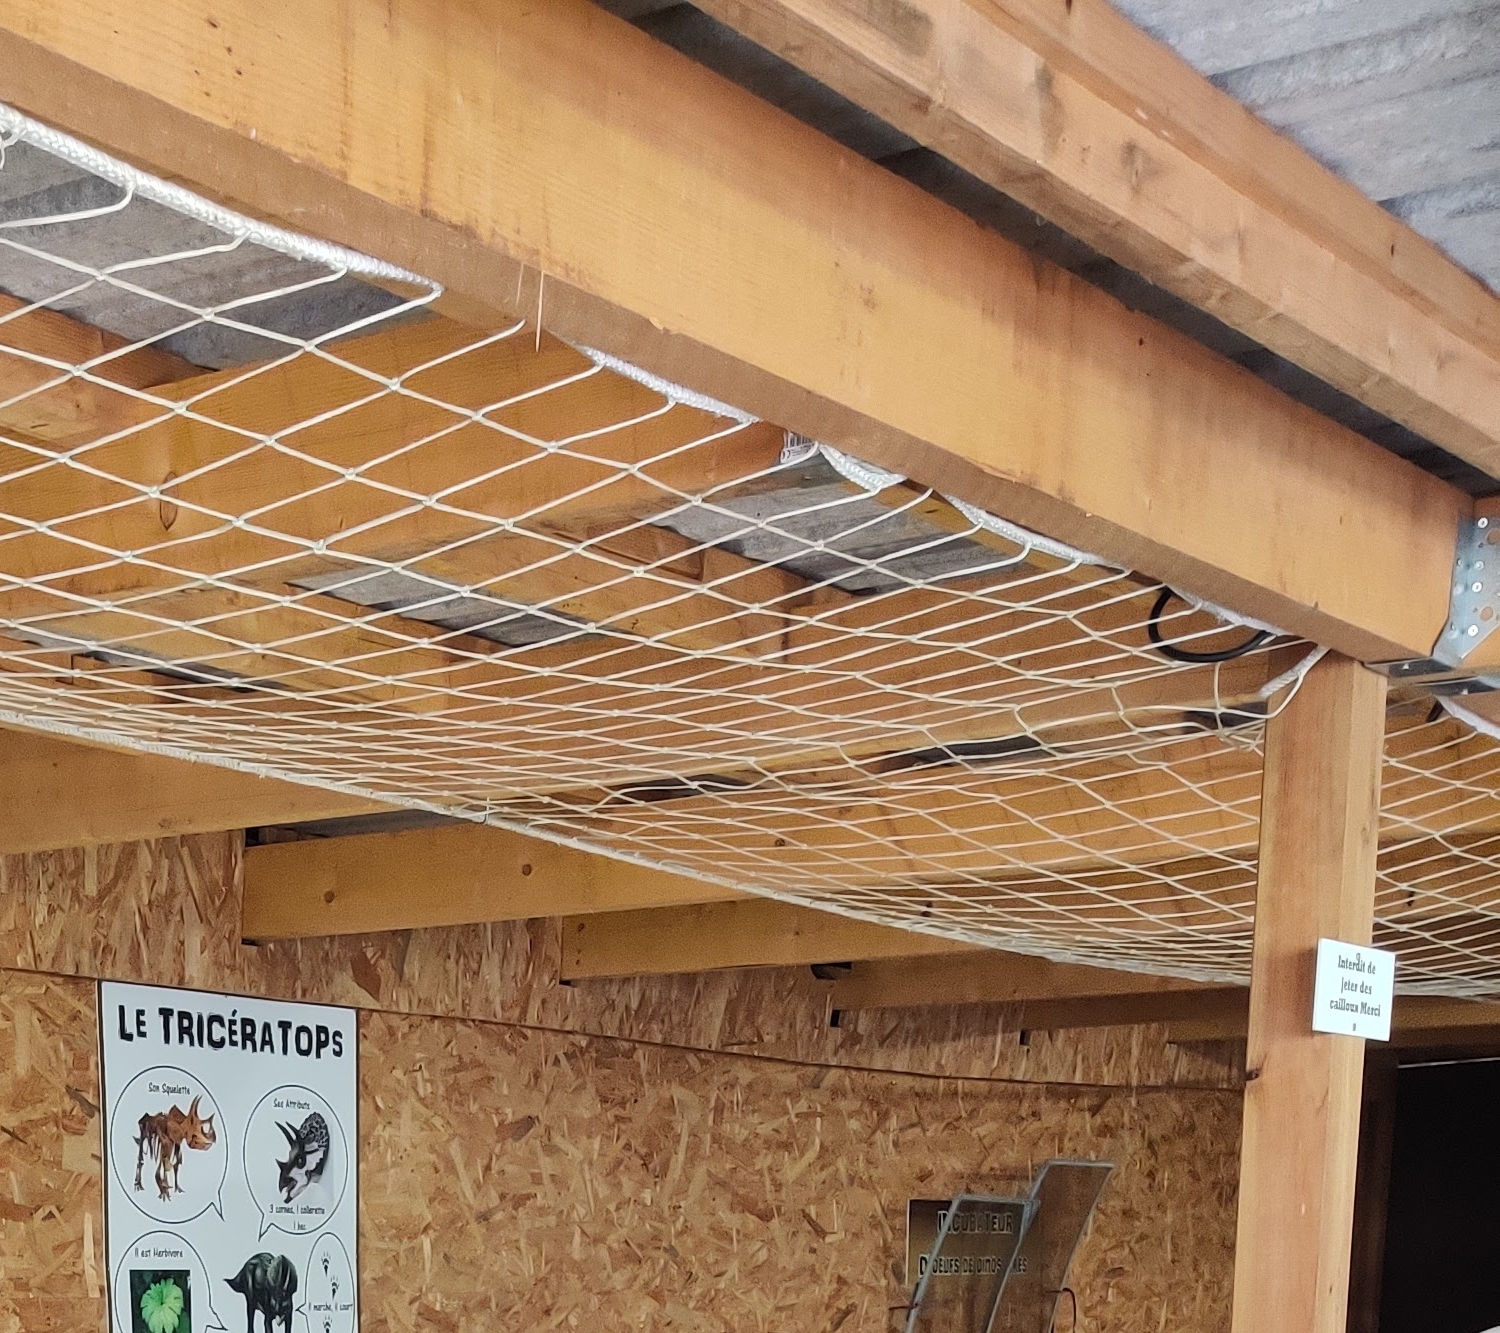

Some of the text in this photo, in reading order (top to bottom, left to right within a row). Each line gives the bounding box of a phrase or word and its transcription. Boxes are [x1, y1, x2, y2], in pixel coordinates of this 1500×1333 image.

[1367, 961, 1376, 975] de
[1359, 980, 1373, 995] des
[1359, 1001, 1381, 1017] Merci
[118, 1004, 344, 1059] LE TRICÉRATOPS
